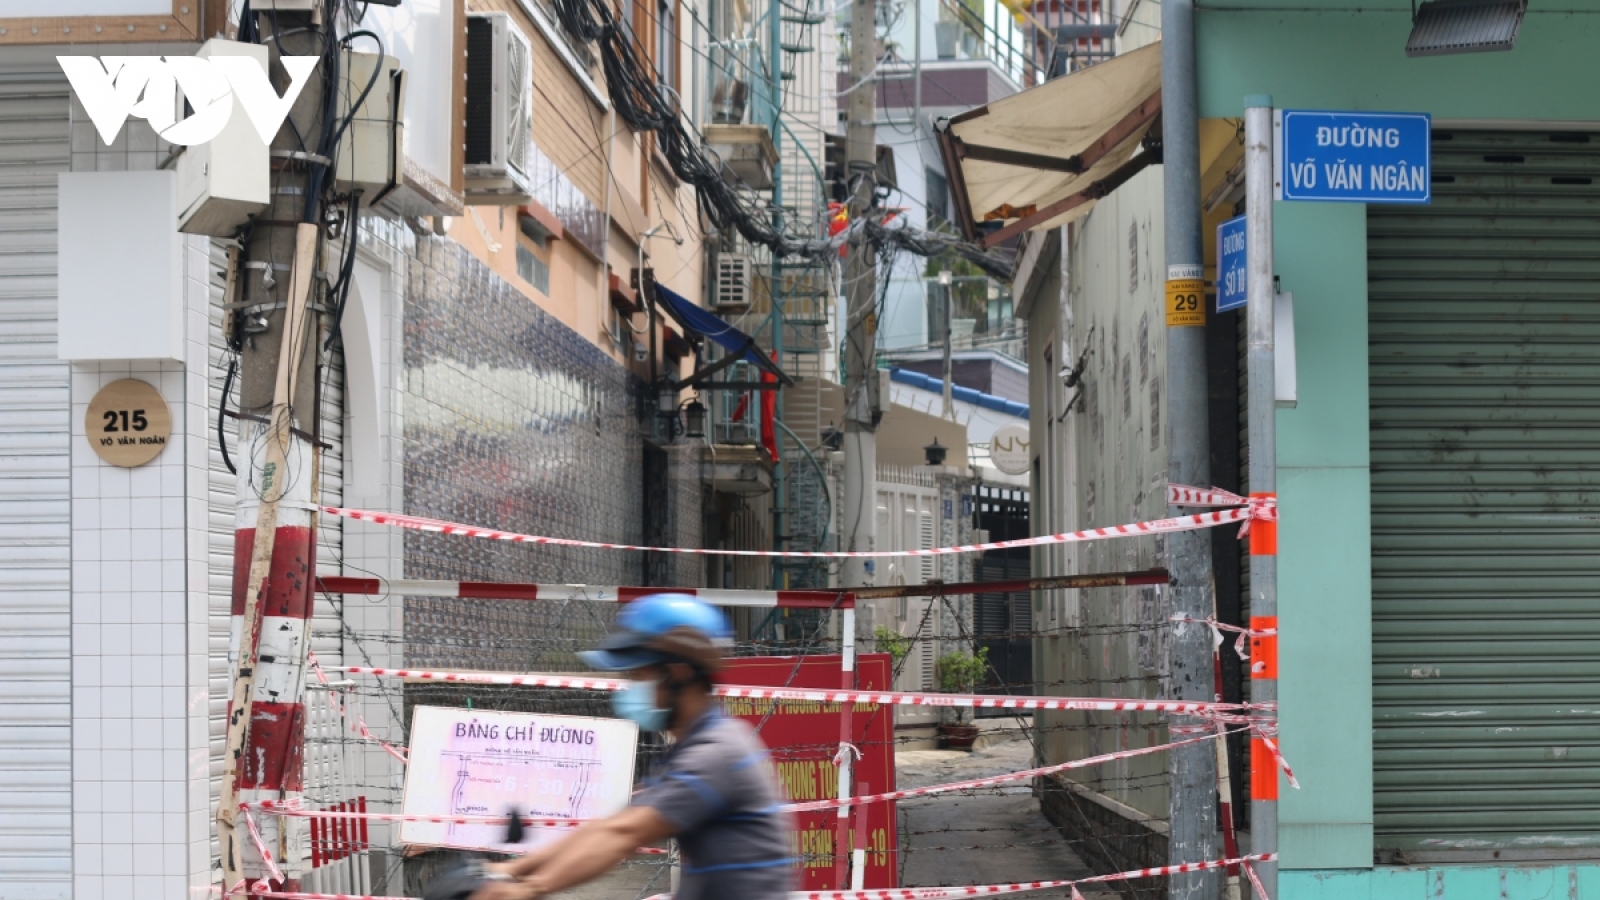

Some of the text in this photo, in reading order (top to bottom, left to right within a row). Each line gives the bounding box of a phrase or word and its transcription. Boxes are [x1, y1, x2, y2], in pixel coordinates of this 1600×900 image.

[1316, 122, 1400, 148] ĐƯỜNG
[1290, 157, 1425, 192] VÕ VĂN NGÂN
[1223, 229, 1245, 256] ĐƯỜNG
[1224, 258, 1237, 297] SỐ
[1175, 294, 1197, 311] 29
[103, 409, 148, 432] 215
[100, 434, 166, 446] VÕ VĂN NGÂN
[455, 718, 596, 746] BẢNG CHỈ ĐƯỜNG
[778, 761, 816, 800] PHONG
